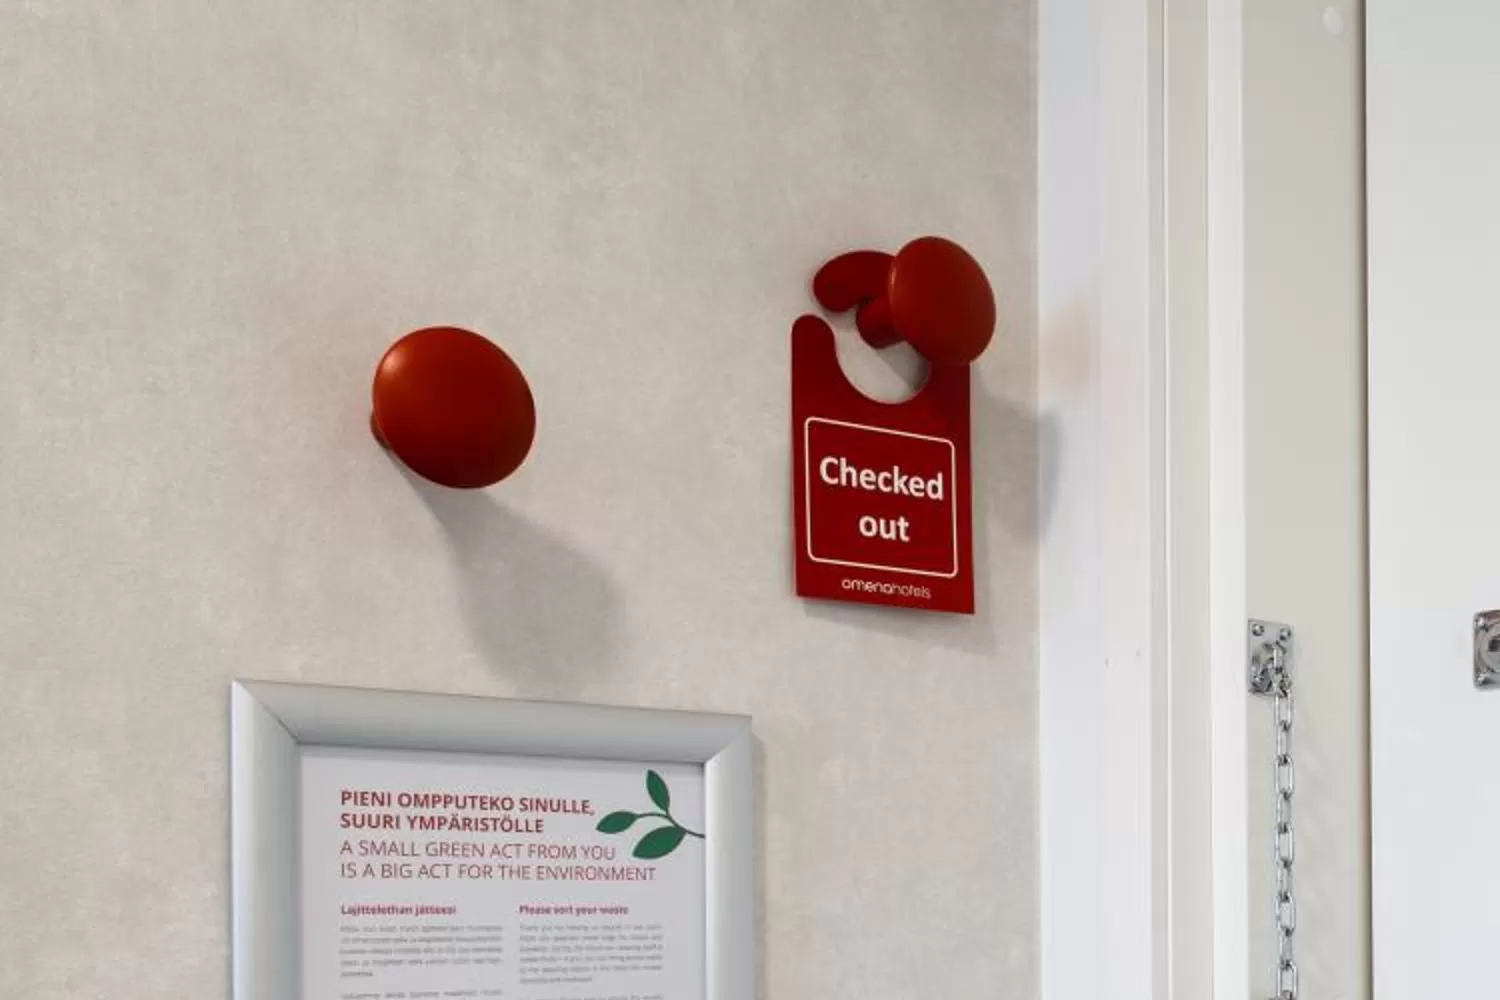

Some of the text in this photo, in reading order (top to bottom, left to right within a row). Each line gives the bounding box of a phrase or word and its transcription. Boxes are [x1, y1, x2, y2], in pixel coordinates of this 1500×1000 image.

[820, 457, 943, 500] Checked
[859, 516, 909, 541] out
[842, 579, 931, 598] omenahotels
[341, 790, 594, 816] PIENI OMPPUTEKO SINULLE,
[341, 813, 544, 833] SUURI YMPÄRISTÖLLE
[340, 840, 616, 860] A SMALL GREEN ACT FROM YOU
[341, 862, 656, 880] IS A BIG ACT FOR THE ENVIRONMENT
